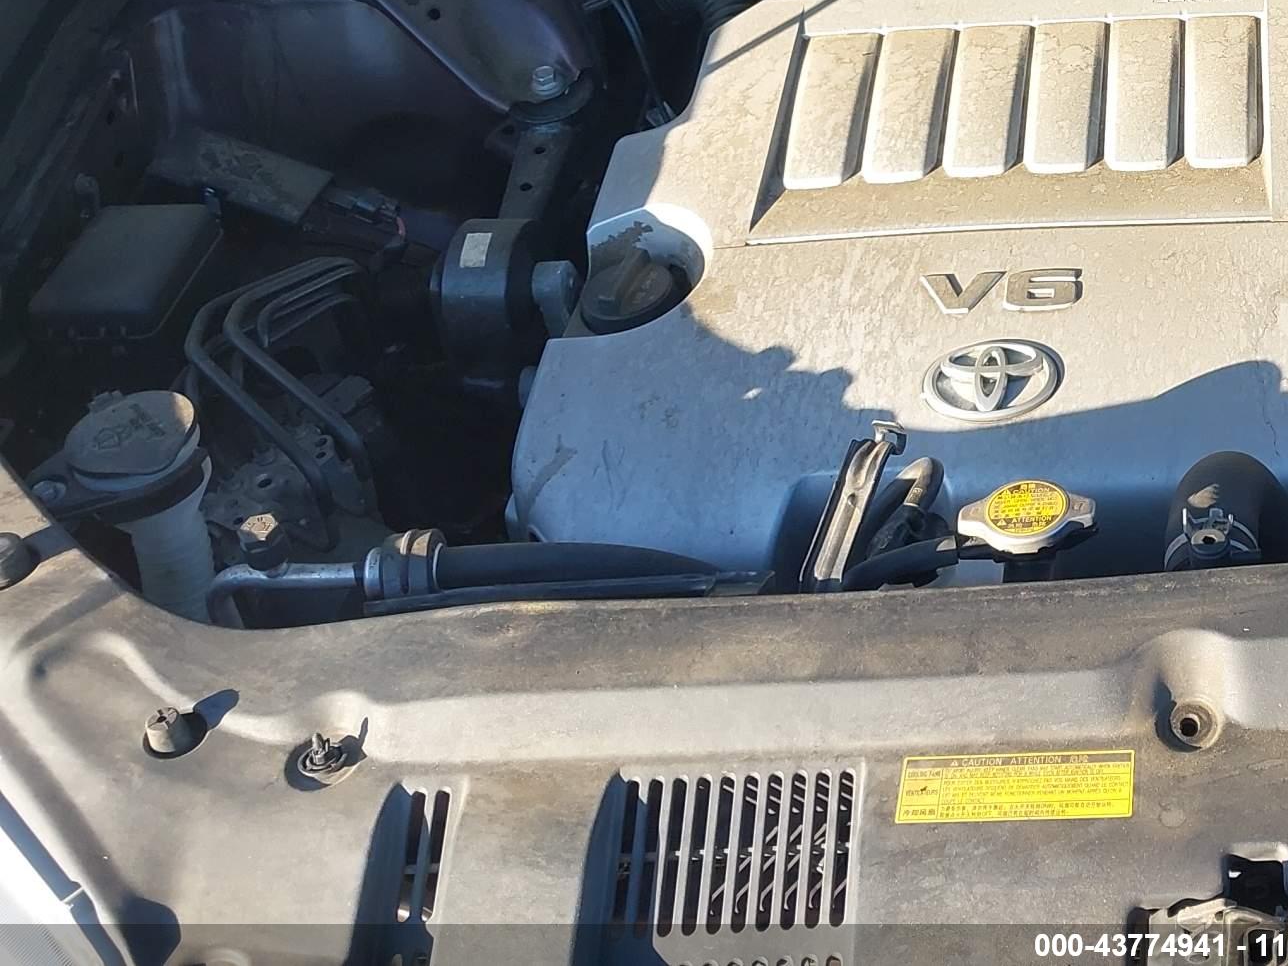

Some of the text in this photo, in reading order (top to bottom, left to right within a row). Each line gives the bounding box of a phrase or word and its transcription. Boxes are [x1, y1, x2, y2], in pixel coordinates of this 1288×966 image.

[920, 268, 1083, 314] V6
[1012, 487, 1050, 495] CAUTION
[1011, 515, 1052, 524] ATTENTION
[961, 755, 1061, 767] CAUTION ATTENTION
